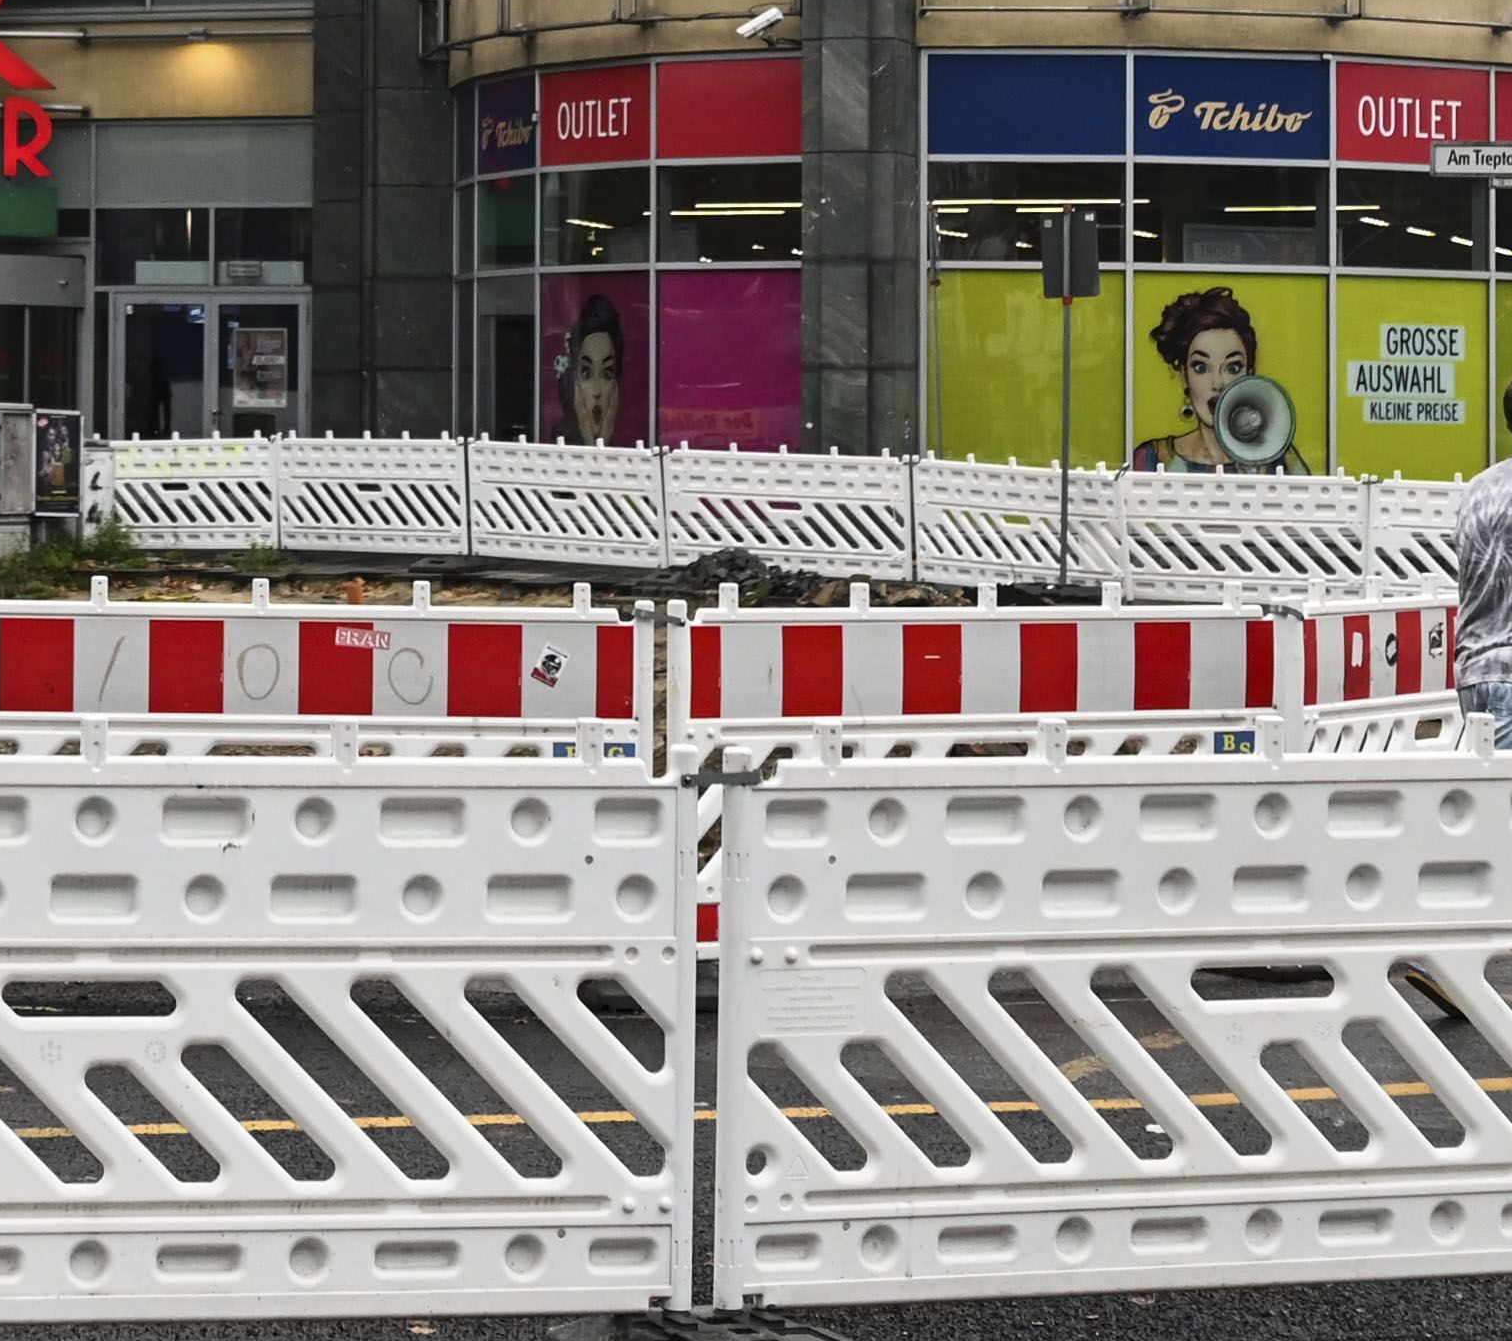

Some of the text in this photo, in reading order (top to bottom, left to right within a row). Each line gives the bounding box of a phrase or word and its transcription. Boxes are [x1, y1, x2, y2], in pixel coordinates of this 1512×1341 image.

[556, 97, 632, 140] OUTLET
[1193, 100, 1313, 134] Tchibo
[1358, 94, 1462, 141] OUTLET
[1447, 149, 1470, 167] Am
[1385, 327, 1460, 357] GROSSE
[1355, 362, 1448, 395] AUSWAHL
[1369, 400, 1459, 423] KLEINE PREISE
[336, 628, 390, 649] FRAN
